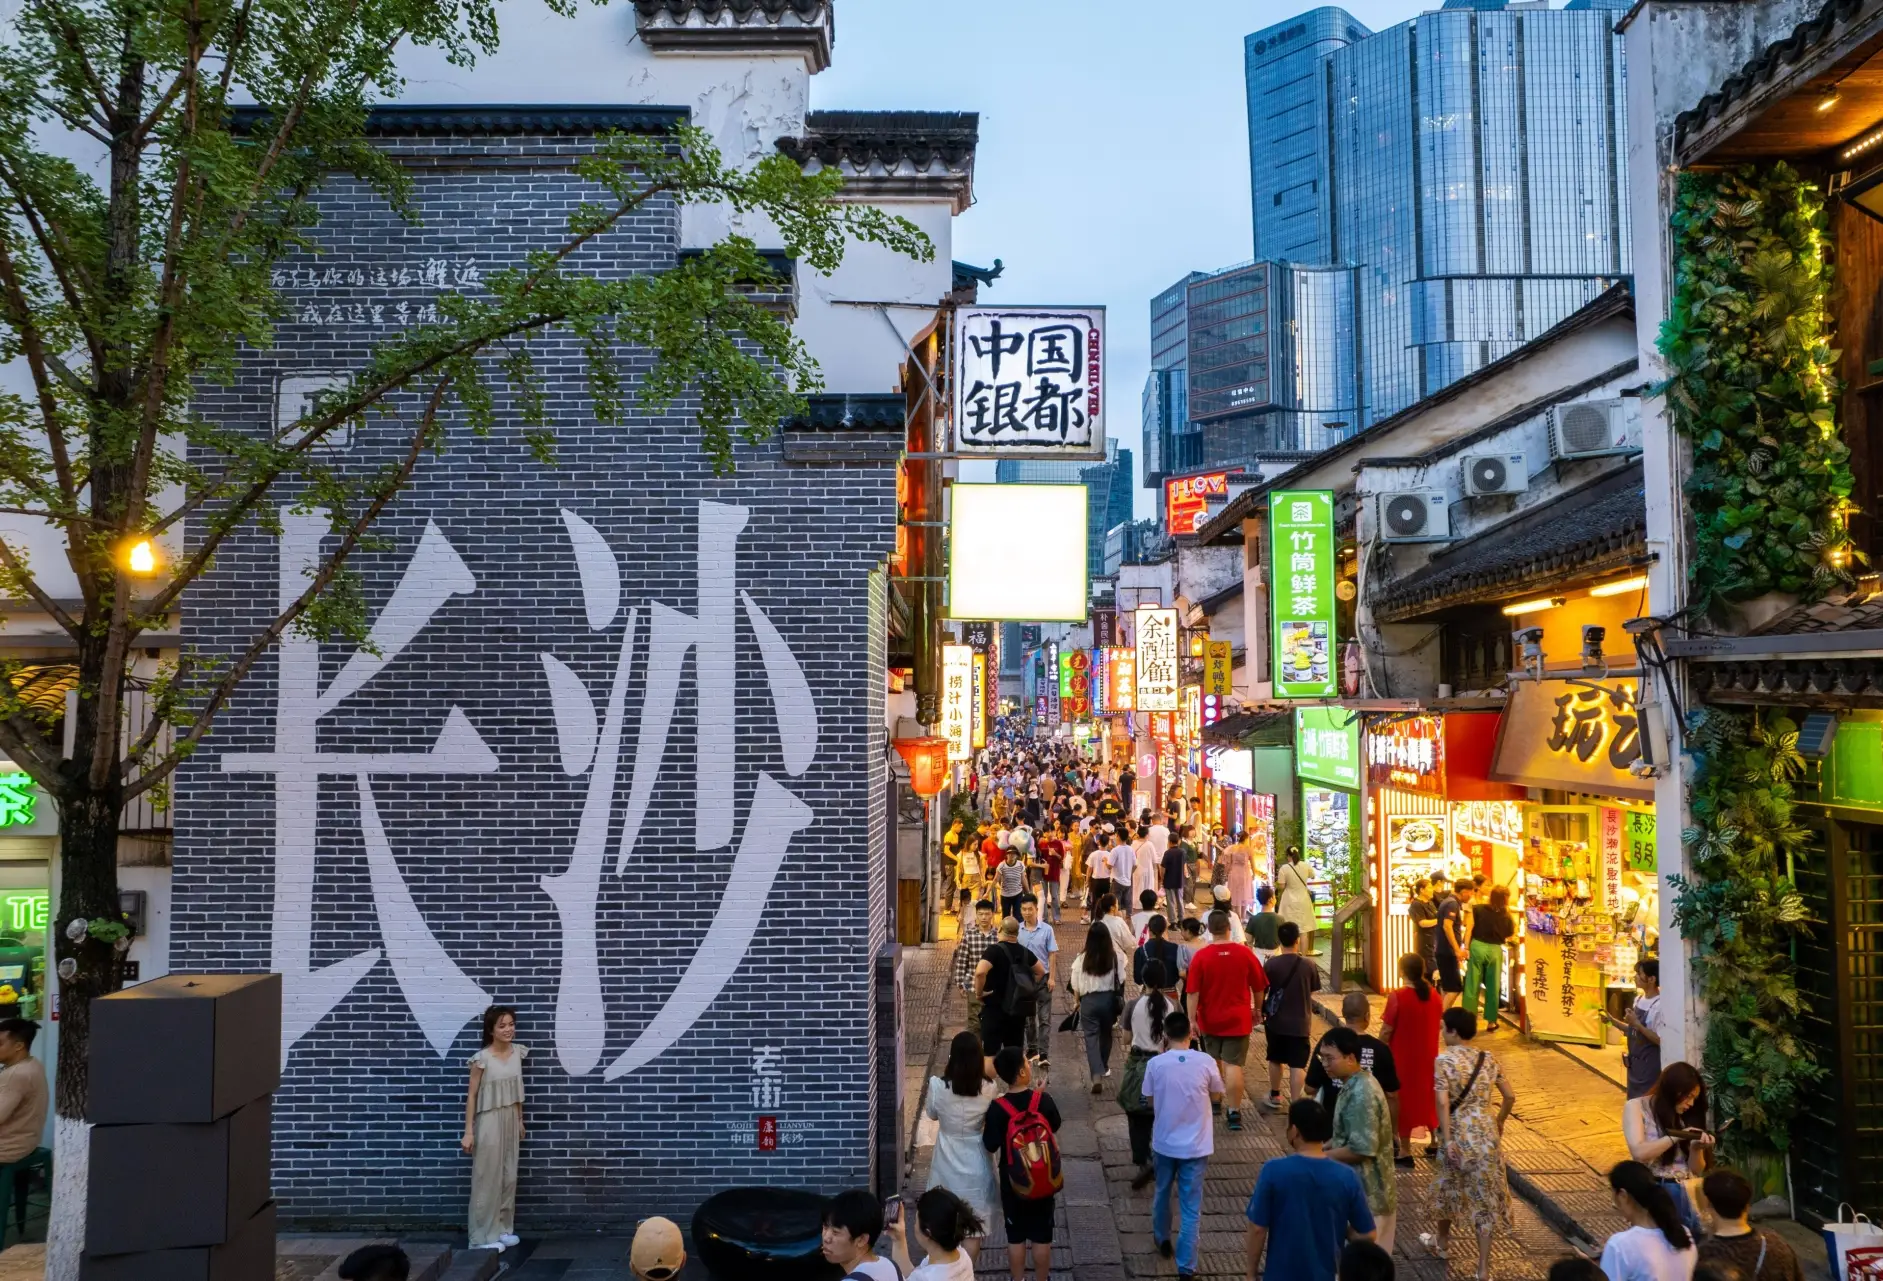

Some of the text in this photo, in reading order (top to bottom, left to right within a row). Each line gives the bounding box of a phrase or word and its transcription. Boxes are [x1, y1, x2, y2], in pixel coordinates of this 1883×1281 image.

[968, 319, 1083, 383] 中国
[964, 376, 1085, 440] 银都
[1183, 477, 1228, 497] LOV
[1290, 531, 1317, 616] 竹筒鲜茶
[220, 500, 818, 1082] 长沙
[752, 1045, 782, 1108] 老街
[731, 1133, 804, 1144] 中国 长沙
